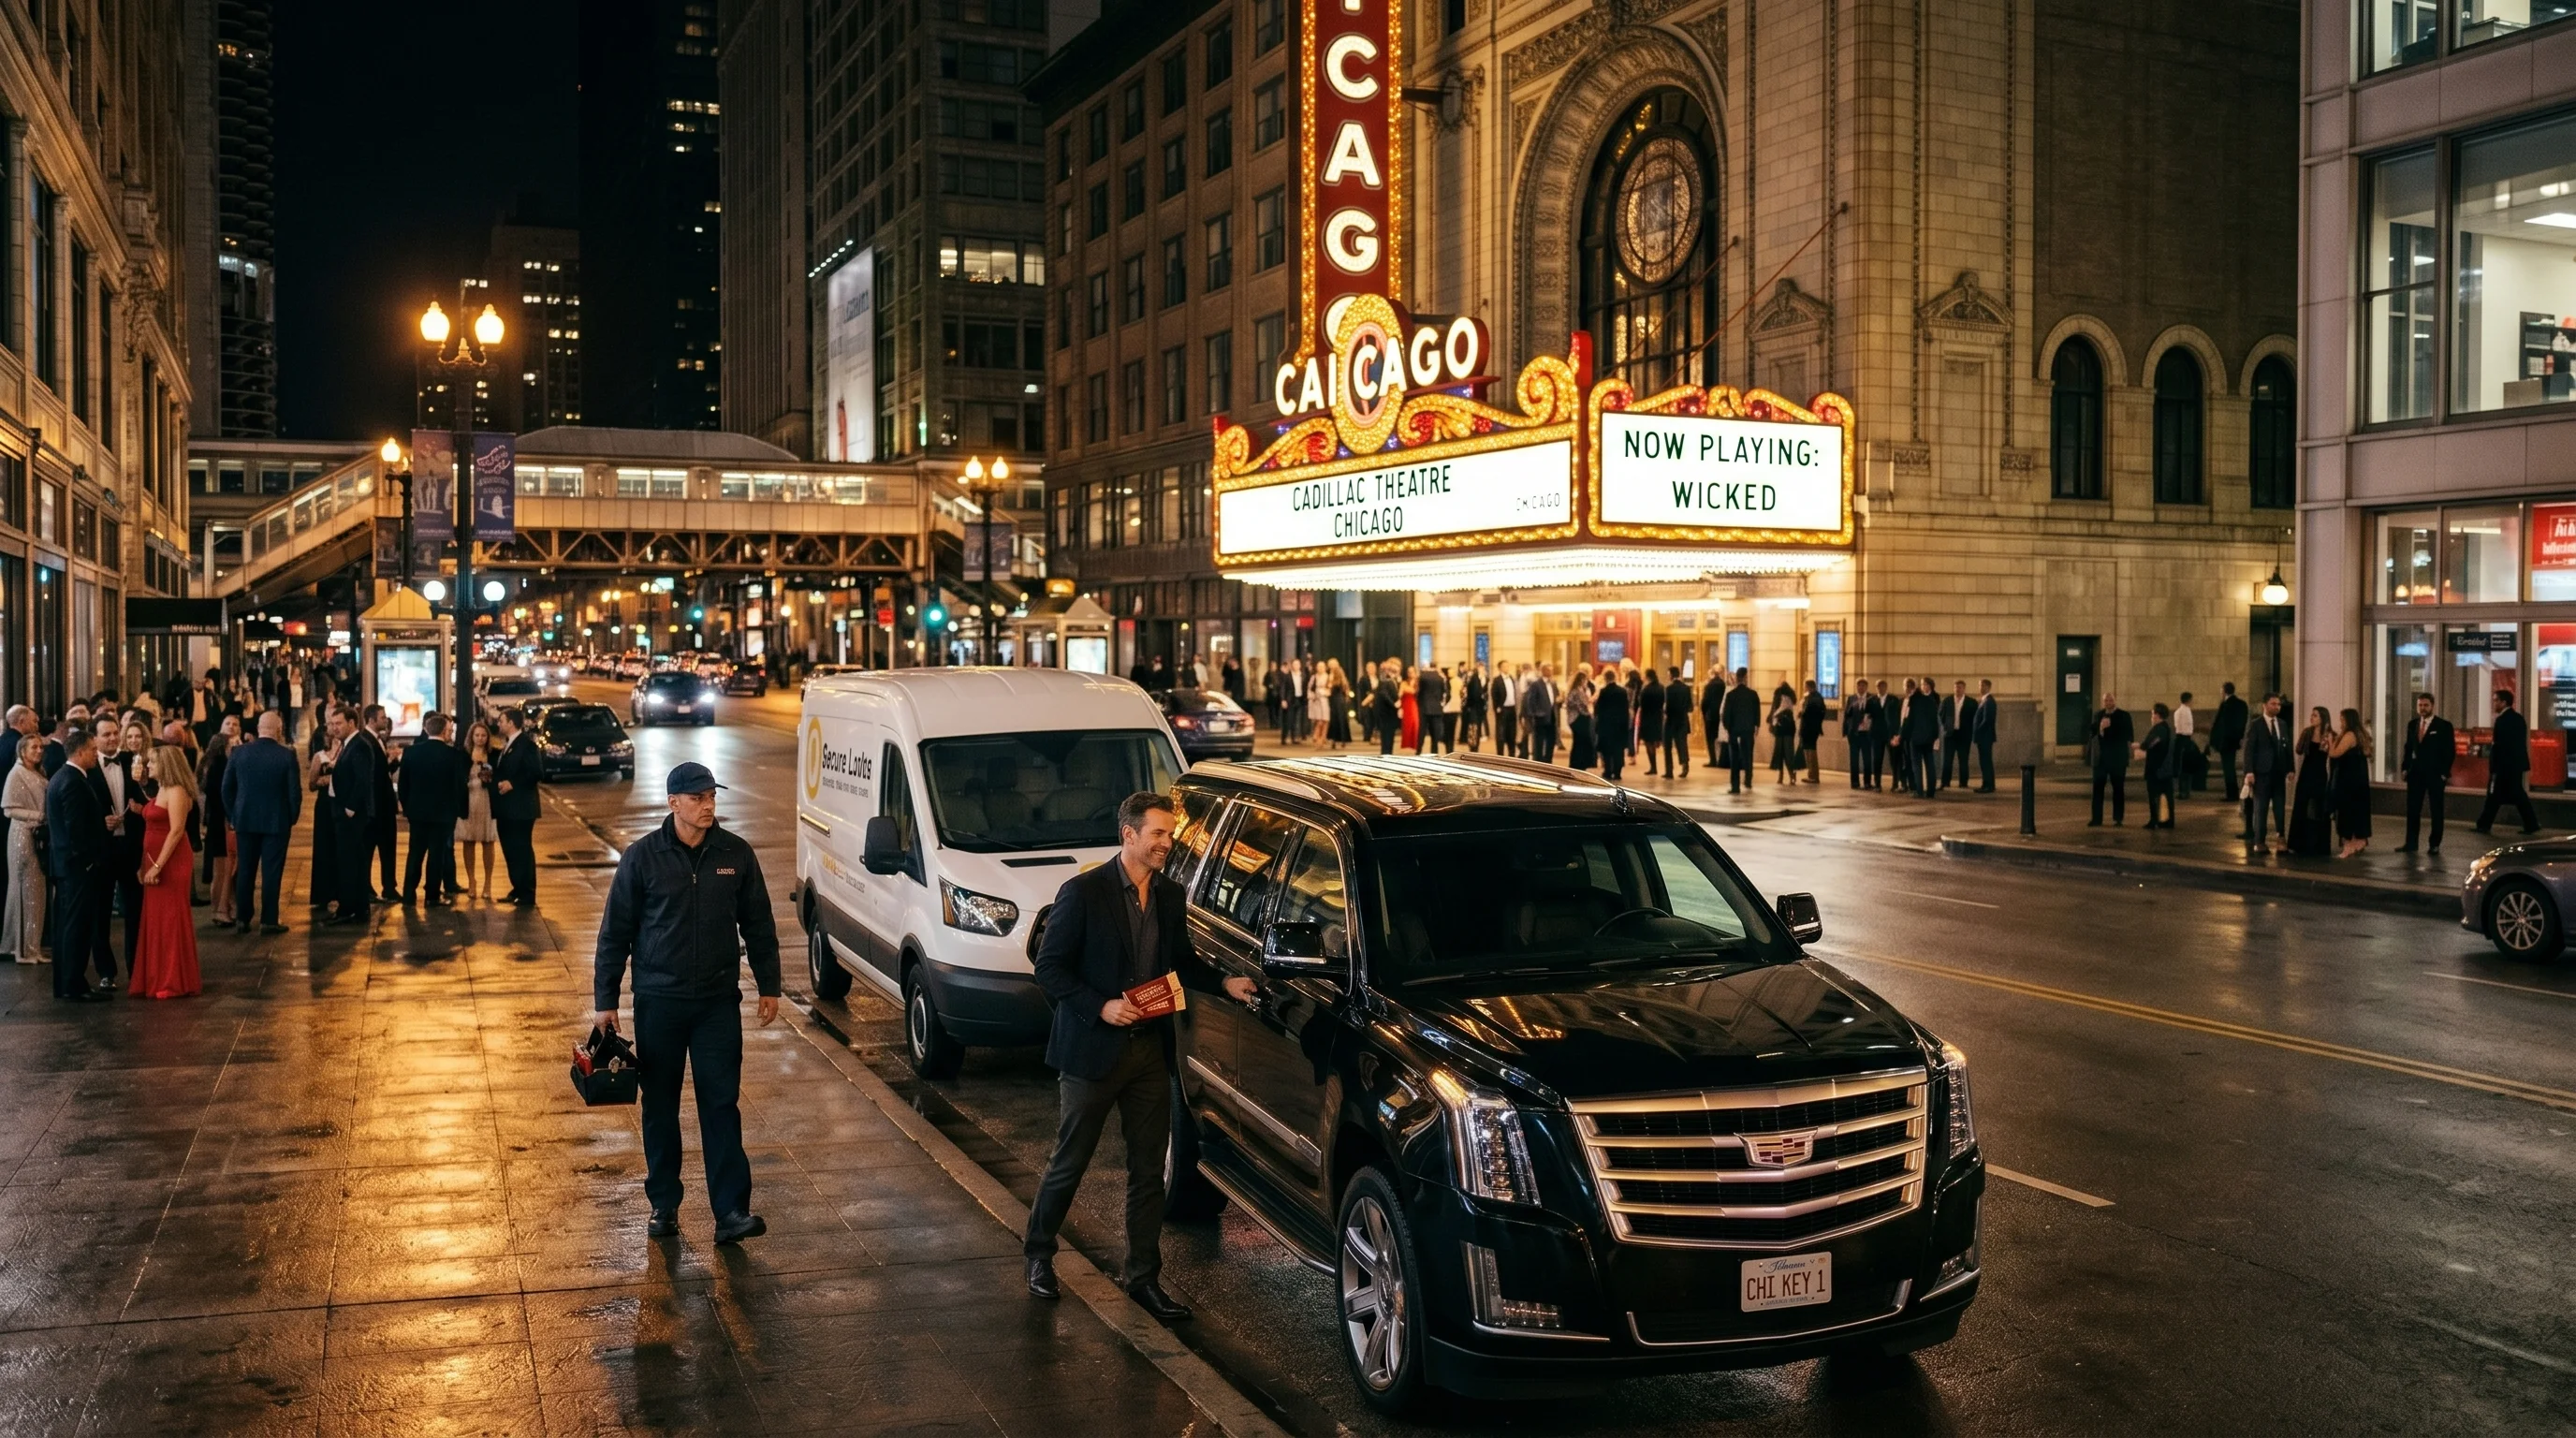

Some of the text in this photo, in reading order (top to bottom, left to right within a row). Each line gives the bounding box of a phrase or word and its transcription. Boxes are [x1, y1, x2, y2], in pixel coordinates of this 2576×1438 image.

[1325, 0, 1382, 350] CAG
[1624, 430, 1820, 467] NOW PLAYING:
[1293, 464, 1452, 511] CADILLAC THEATRE
[1672, 480, 1777, 511] WICKED
[1334, 506, 1404, 538] CHICAGO
[822, 742, 847, 774] Secure
[1747, 1269, 1826, 1301] CHI KEY 1
